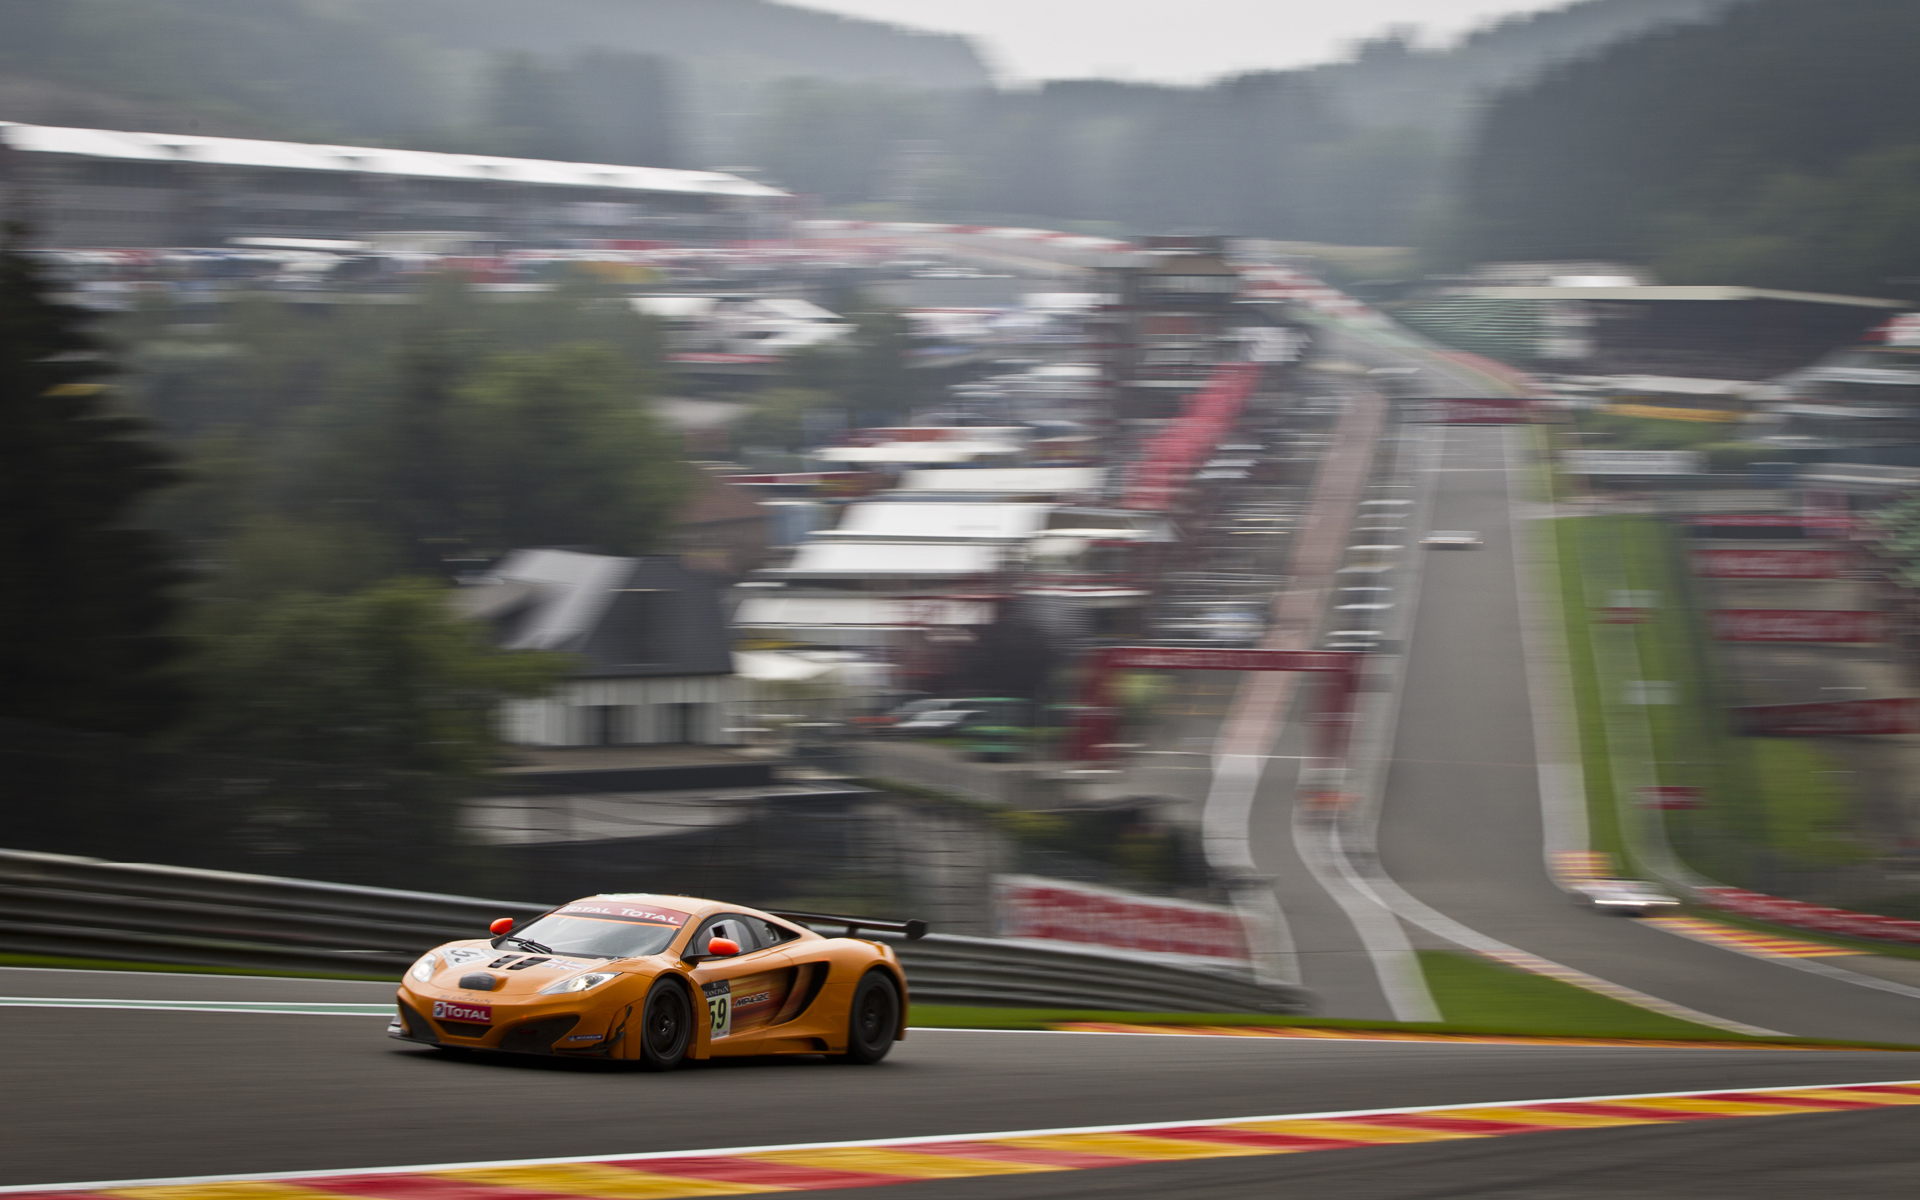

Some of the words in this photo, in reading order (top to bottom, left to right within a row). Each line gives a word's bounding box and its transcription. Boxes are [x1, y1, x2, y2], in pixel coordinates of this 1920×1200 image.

[562, 905, 612, 914] TOTAL
[621, 907, 679, 924] TOTAL
[445, 1004, 490, 1020] TOTAL
[708, 998, 727, 1030] 59
